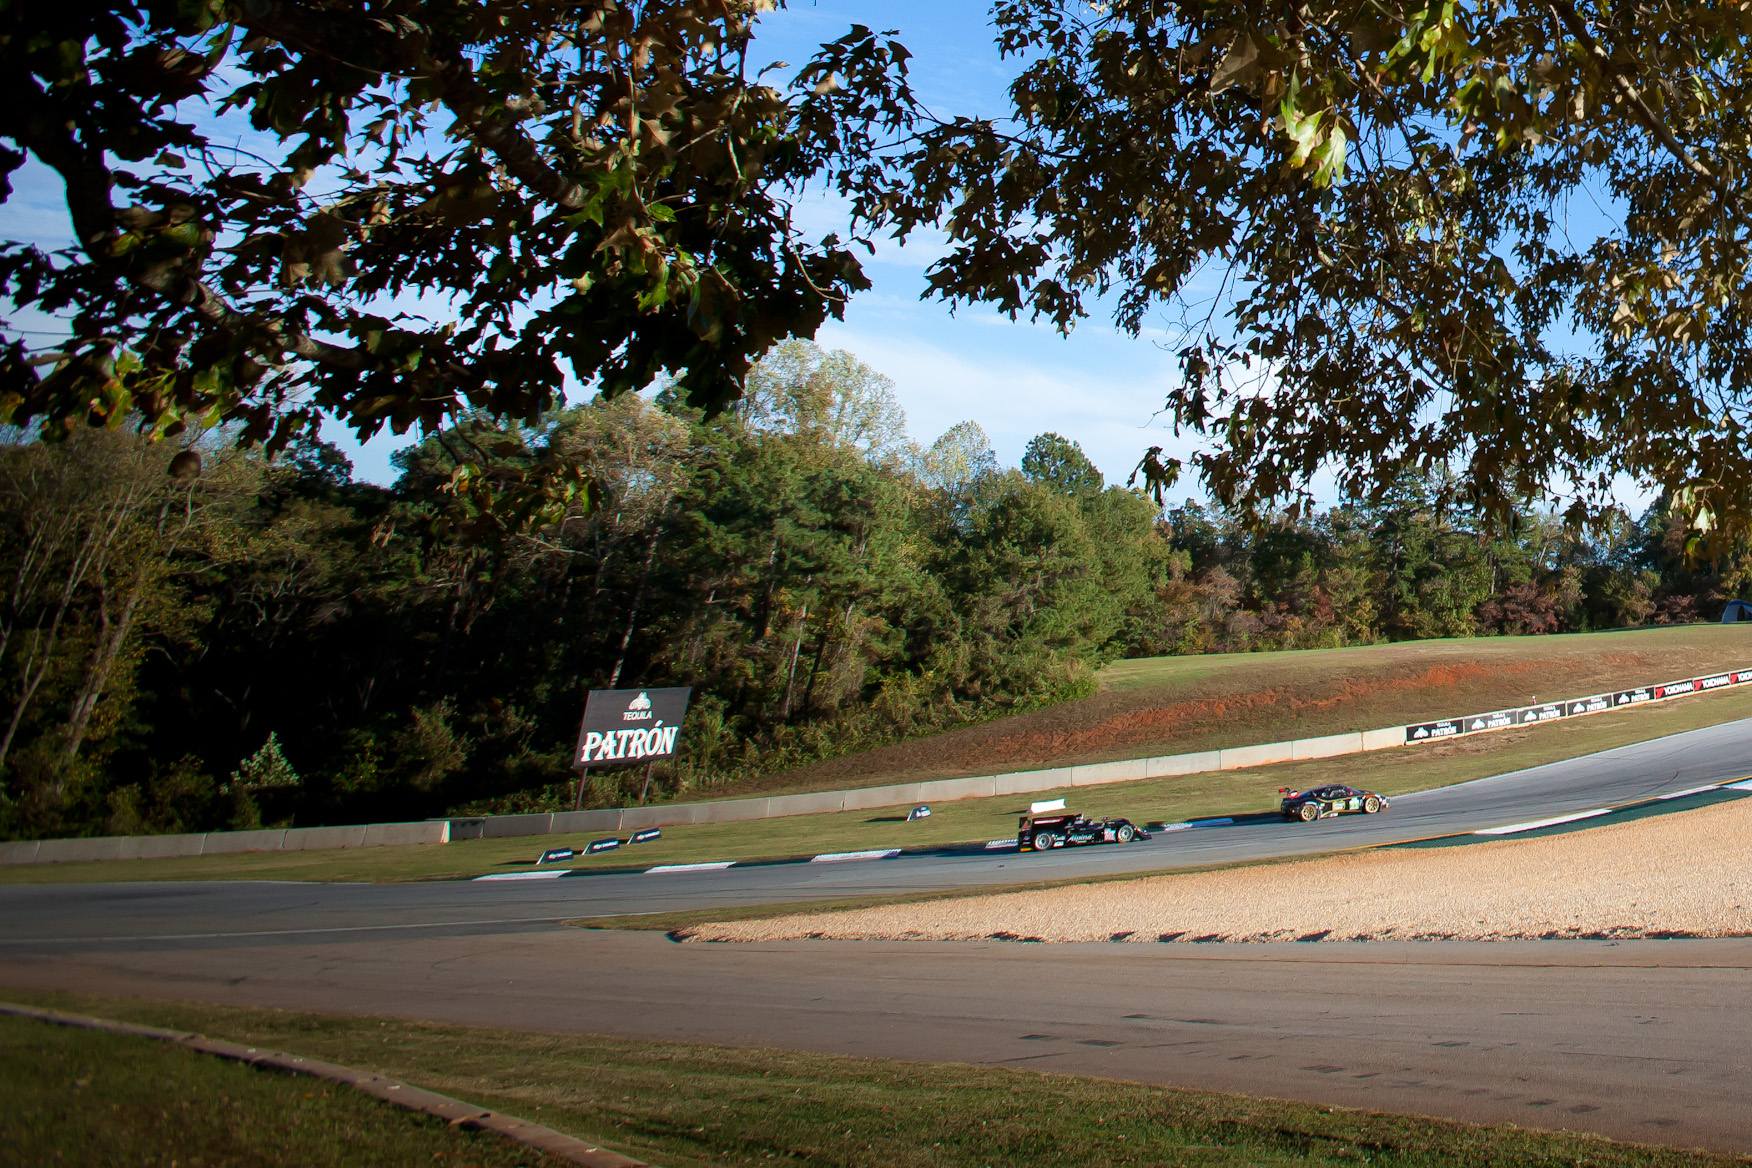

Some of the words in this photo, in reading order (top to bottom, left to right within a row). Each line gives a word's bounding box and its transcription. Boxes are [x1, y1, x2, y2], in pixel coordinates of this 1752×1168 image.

[1664, 681, 1693, 695] YOKOHAMA
[1702, 675, 1730, 688] YOKOHAMA
[623, 711, 652, 721] TEQUILA
[580, 719, 679, 762] PATRÓN
